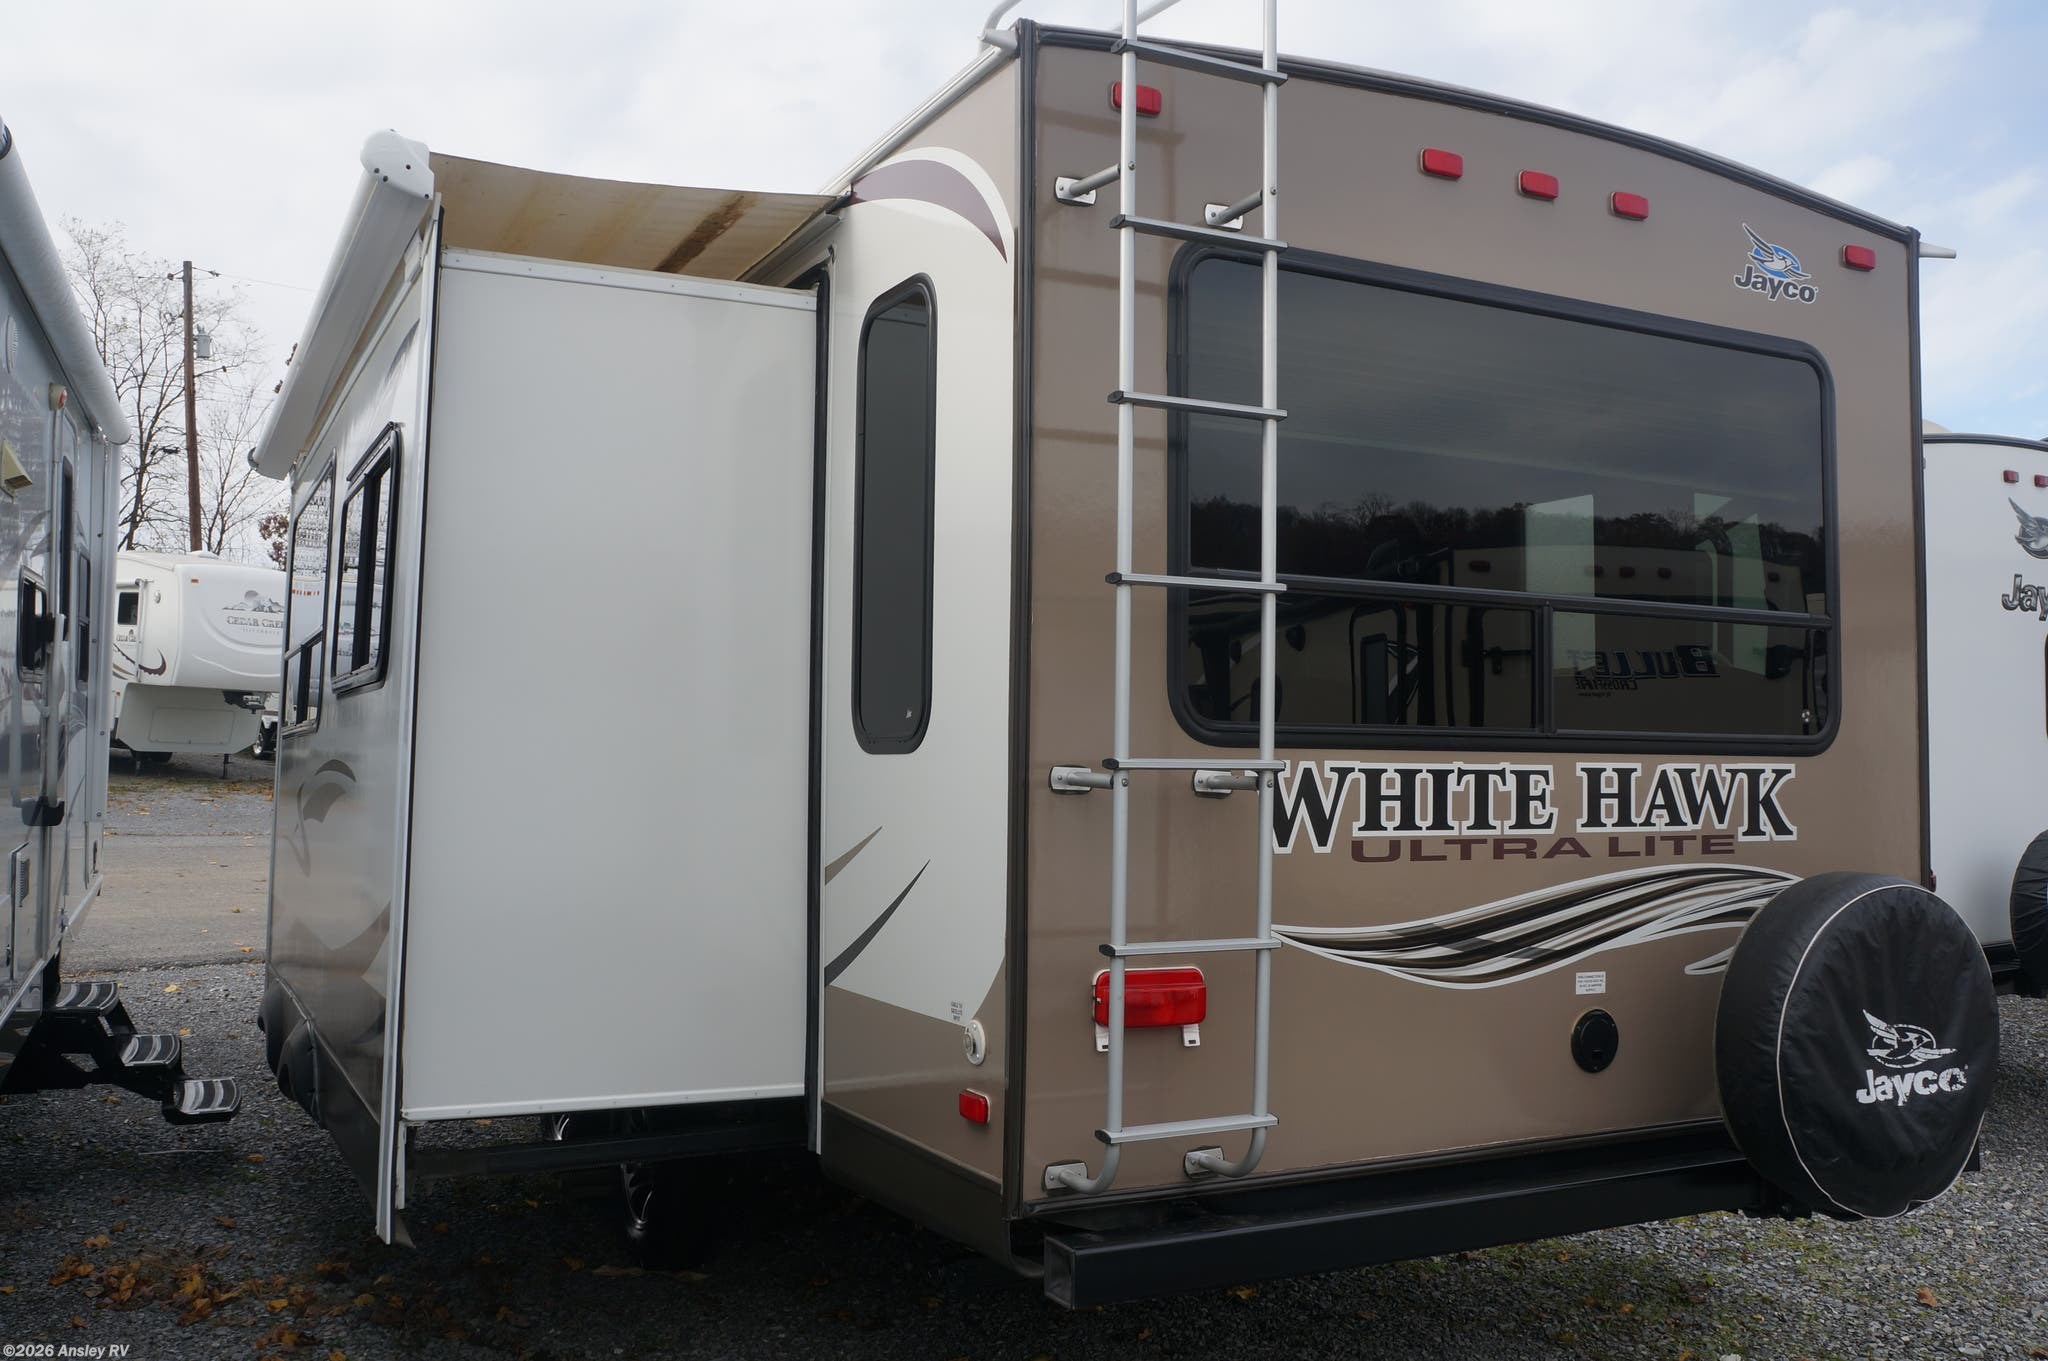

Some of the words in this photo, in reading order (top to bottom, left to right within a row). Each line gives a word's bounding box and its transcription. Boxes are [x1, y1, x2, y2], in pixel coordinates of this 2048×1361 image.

[1735, 264, 1819, 304] Jayco
[226, 615, 260, 628] CEDAR
[261, 618, 284, 630] CRE
[1272, 760, 1558, 855] WHITE
[1576, 762, 1798, 842] HAWK
[1351, 836, 1591, 863] ULTRA
[1608, 834, 1735, 857] LITE
[1855, 1067, 1968, 1107] Jayco
